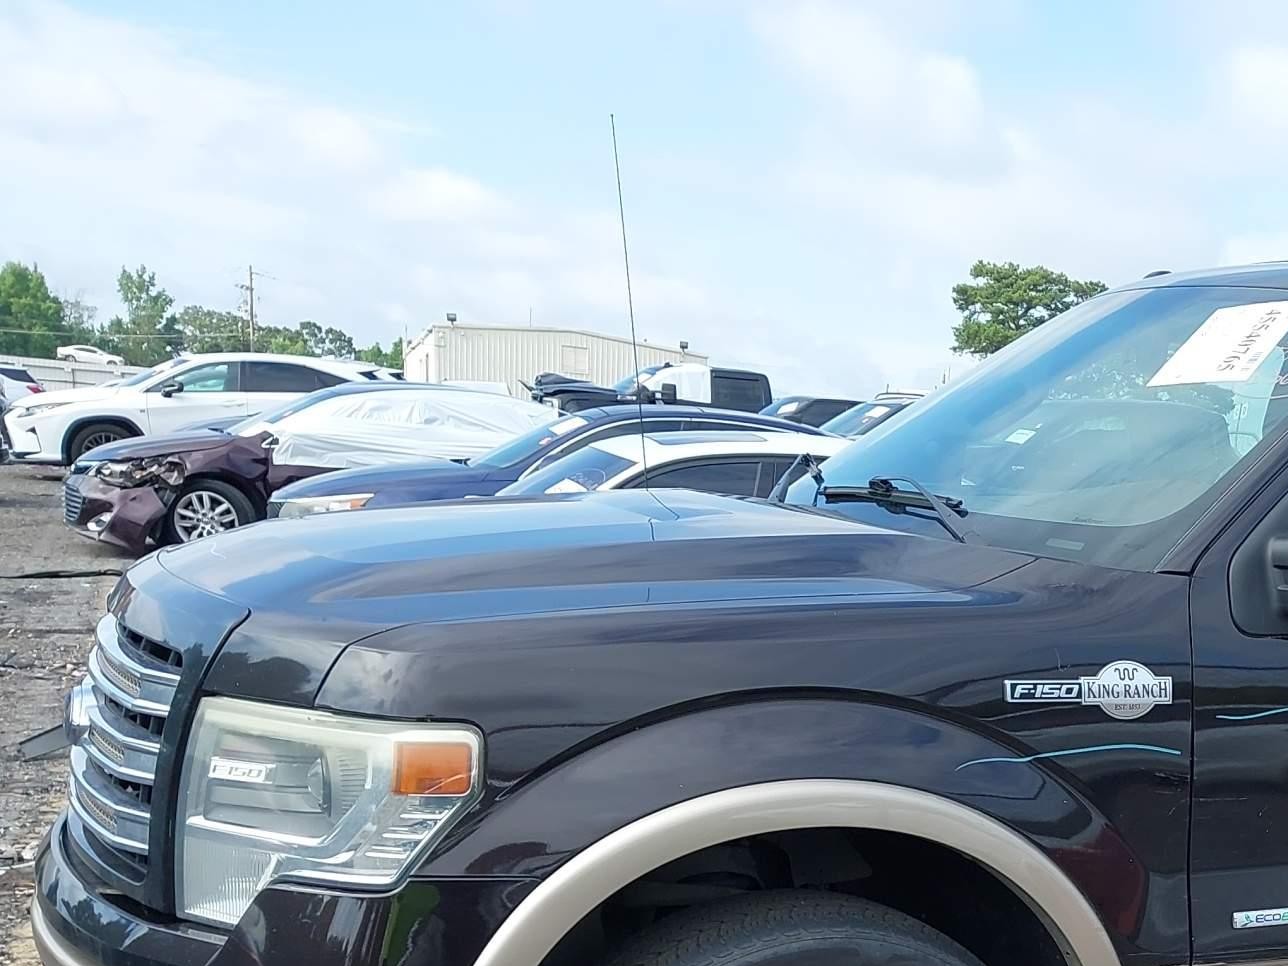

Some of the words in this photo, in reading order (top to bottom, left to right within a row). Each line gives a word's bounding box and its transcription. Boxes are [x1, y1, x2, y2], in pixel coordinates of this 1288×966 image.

[1013, 684, 1080, 698] F-150
[1087, 681, 1121, 699] KING
[1123, 681, 1169, 699] RANCH
